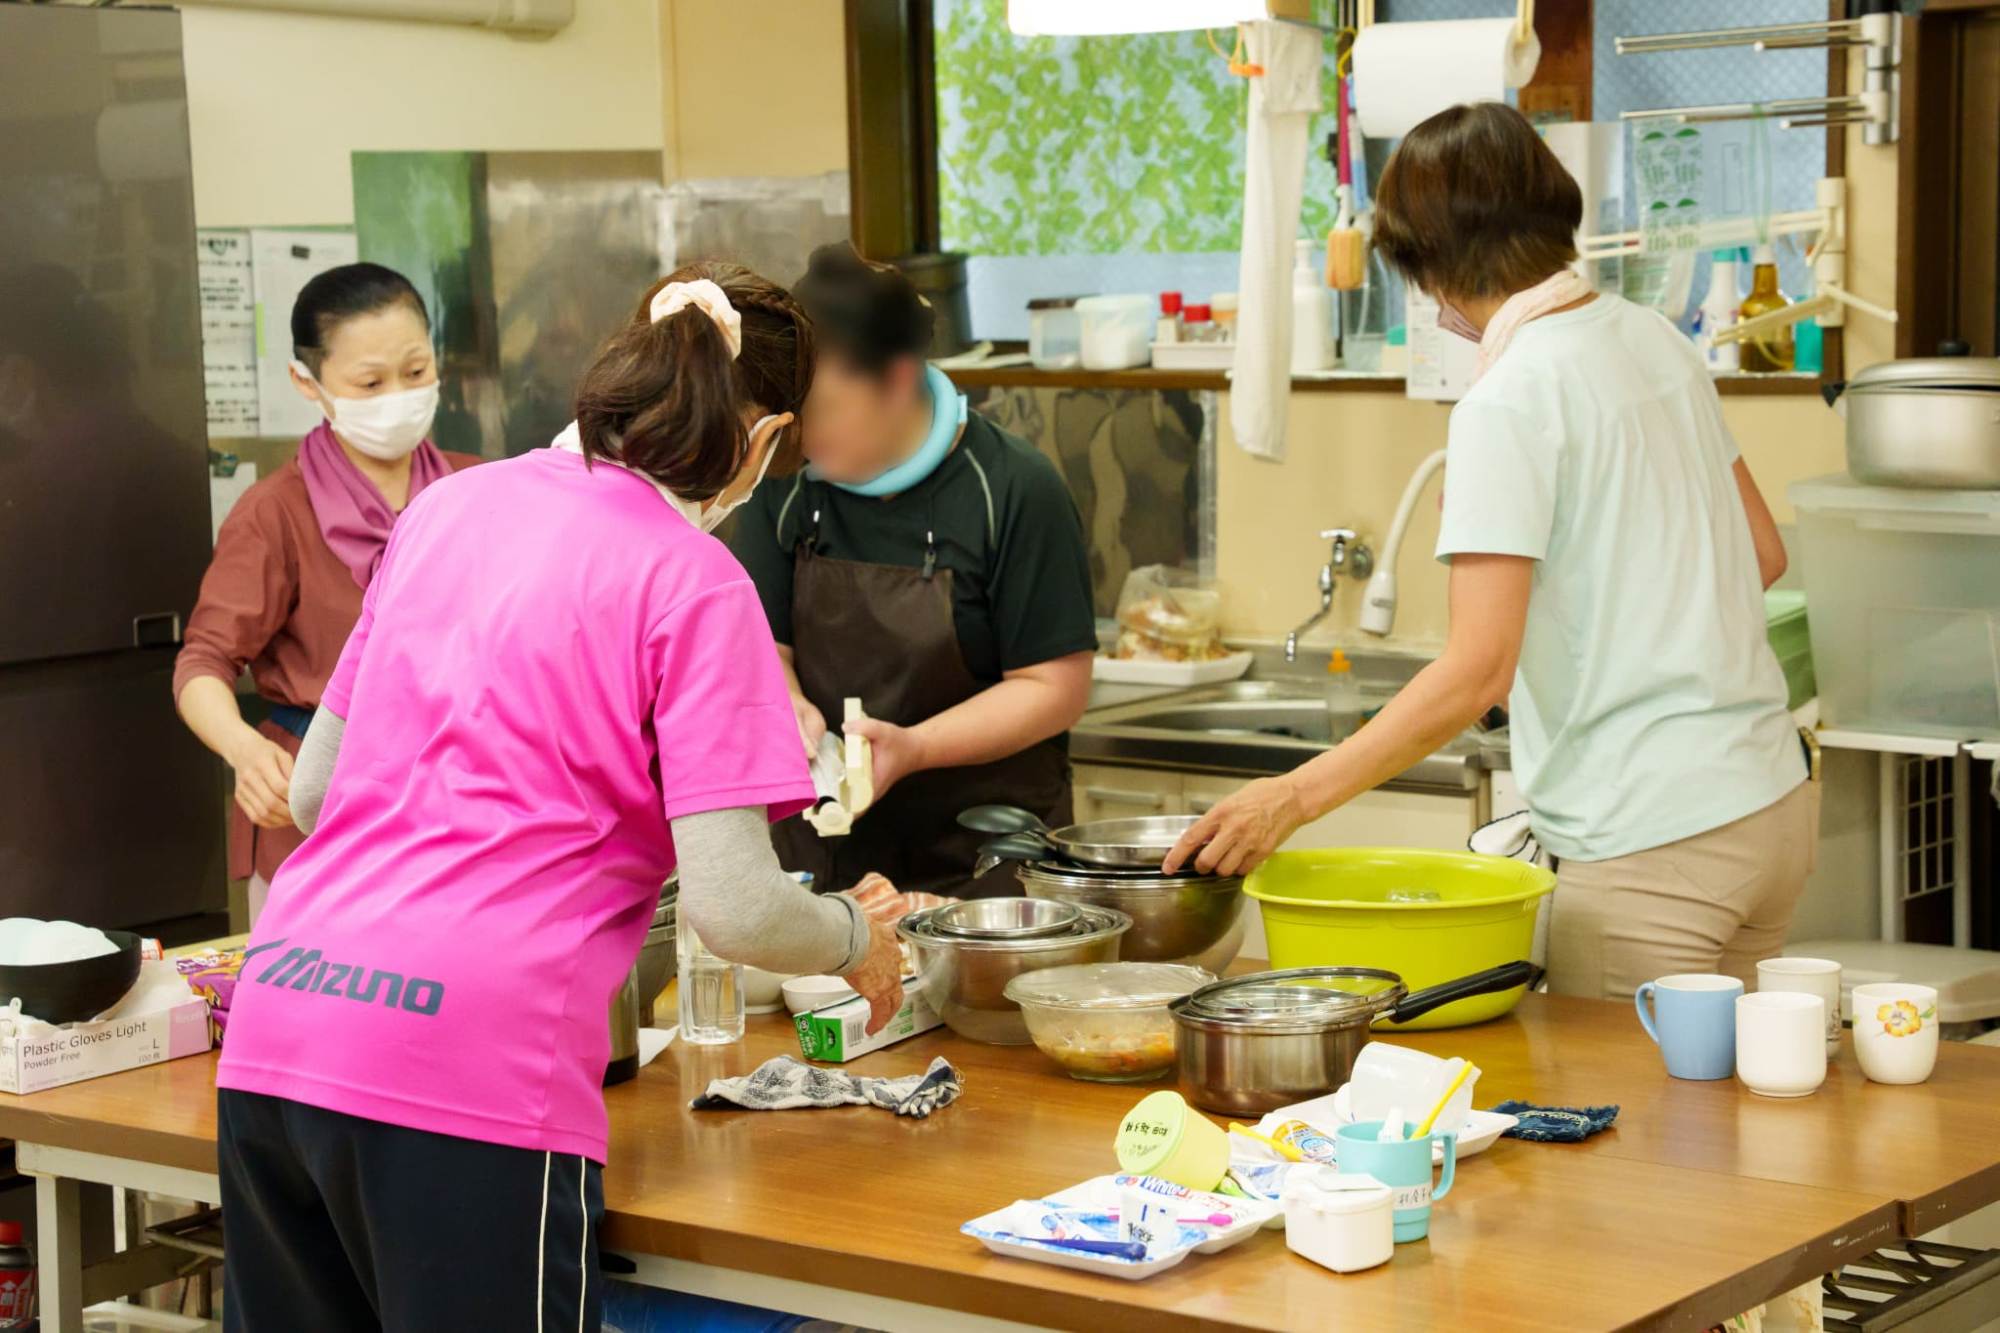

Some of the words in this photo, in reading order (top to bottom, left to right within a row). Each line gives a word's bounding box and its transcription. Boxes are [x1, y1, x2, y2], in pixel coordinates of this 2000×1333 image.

[23, 1039, 66, 1058] Plastic
[70, 1031, 112, 1048] Gloves
[116, 1021, 147, 1040] Light
[152, 1038, 160, 1049] L
[23, 1056, 57, 1070] Powder
[60, 1051, 81, 1063] Free
